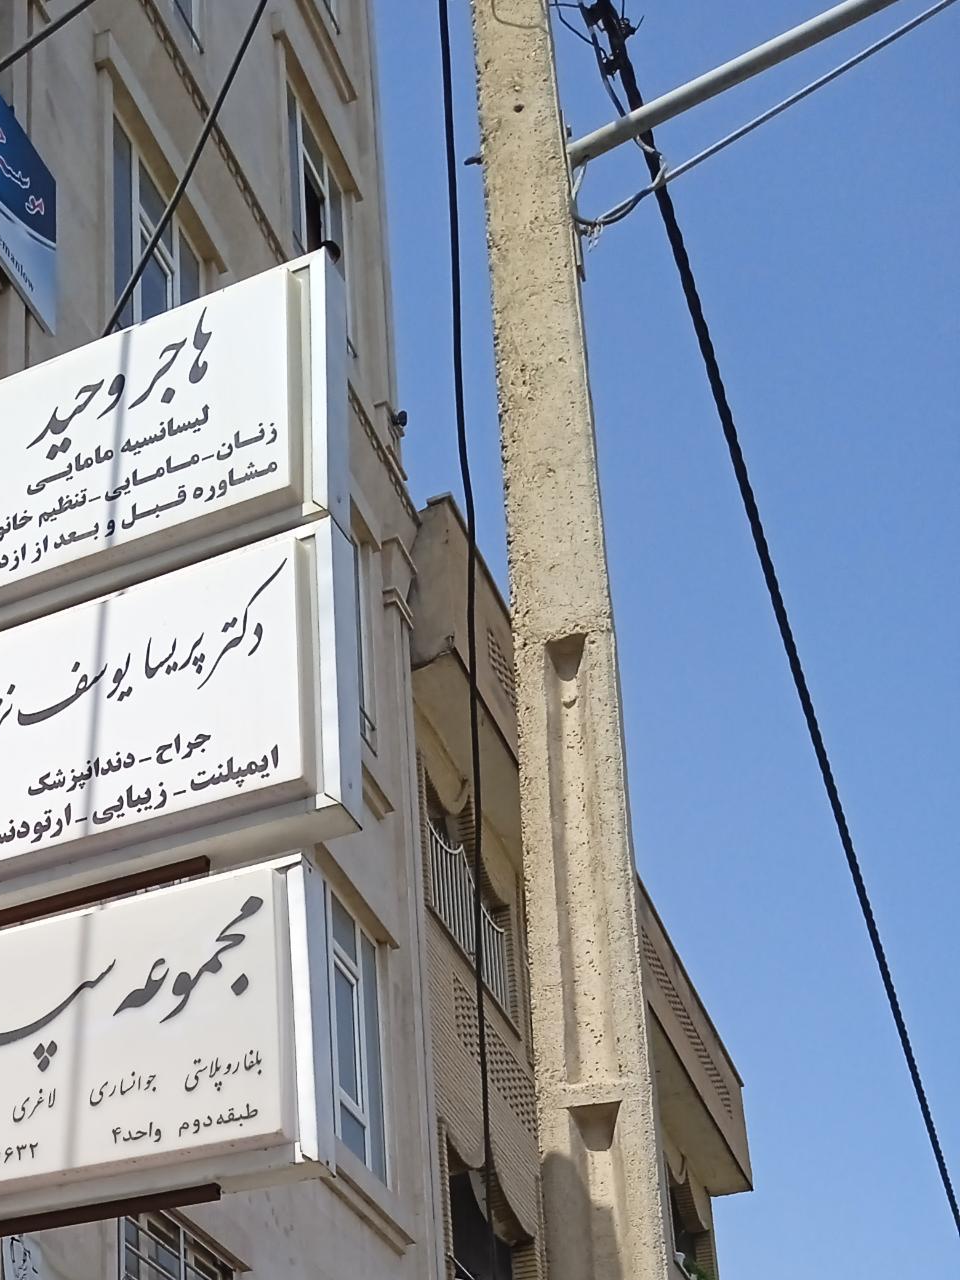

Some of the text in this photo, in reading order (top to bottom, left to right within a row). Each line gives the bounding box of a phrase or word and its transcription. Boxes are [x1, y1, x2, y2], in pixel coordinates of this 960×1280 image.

[26, 306, 213, 462] هاجر وحید
[26, 403, 210, 497] لیسانسیه مامایی
[192, 459, 278, 503] مشاوره
[105, 518, 116, 538] و
[121, 484, 187, 530] قبل
[31, 535, 50, 565] از
[53, 522, 100, 551] بعد
[197, 557, 288, 690] دکتر
[144, 631, 207, 681] پریسا
[16, 652, 133, 728] یوسف
[27, 733, 212, 798] جراح دندانپزشک
[190, 744, 280, 794] ایمپلنت
[92, 781, 168, 827] زیبایی
[113, 895, 265, 1025] مجموعه
[12, 1087, 57, 1123] لاغری
[178, 1114, 213, 1138] دوم
[217, 1103, 259, 1129] طبقه
